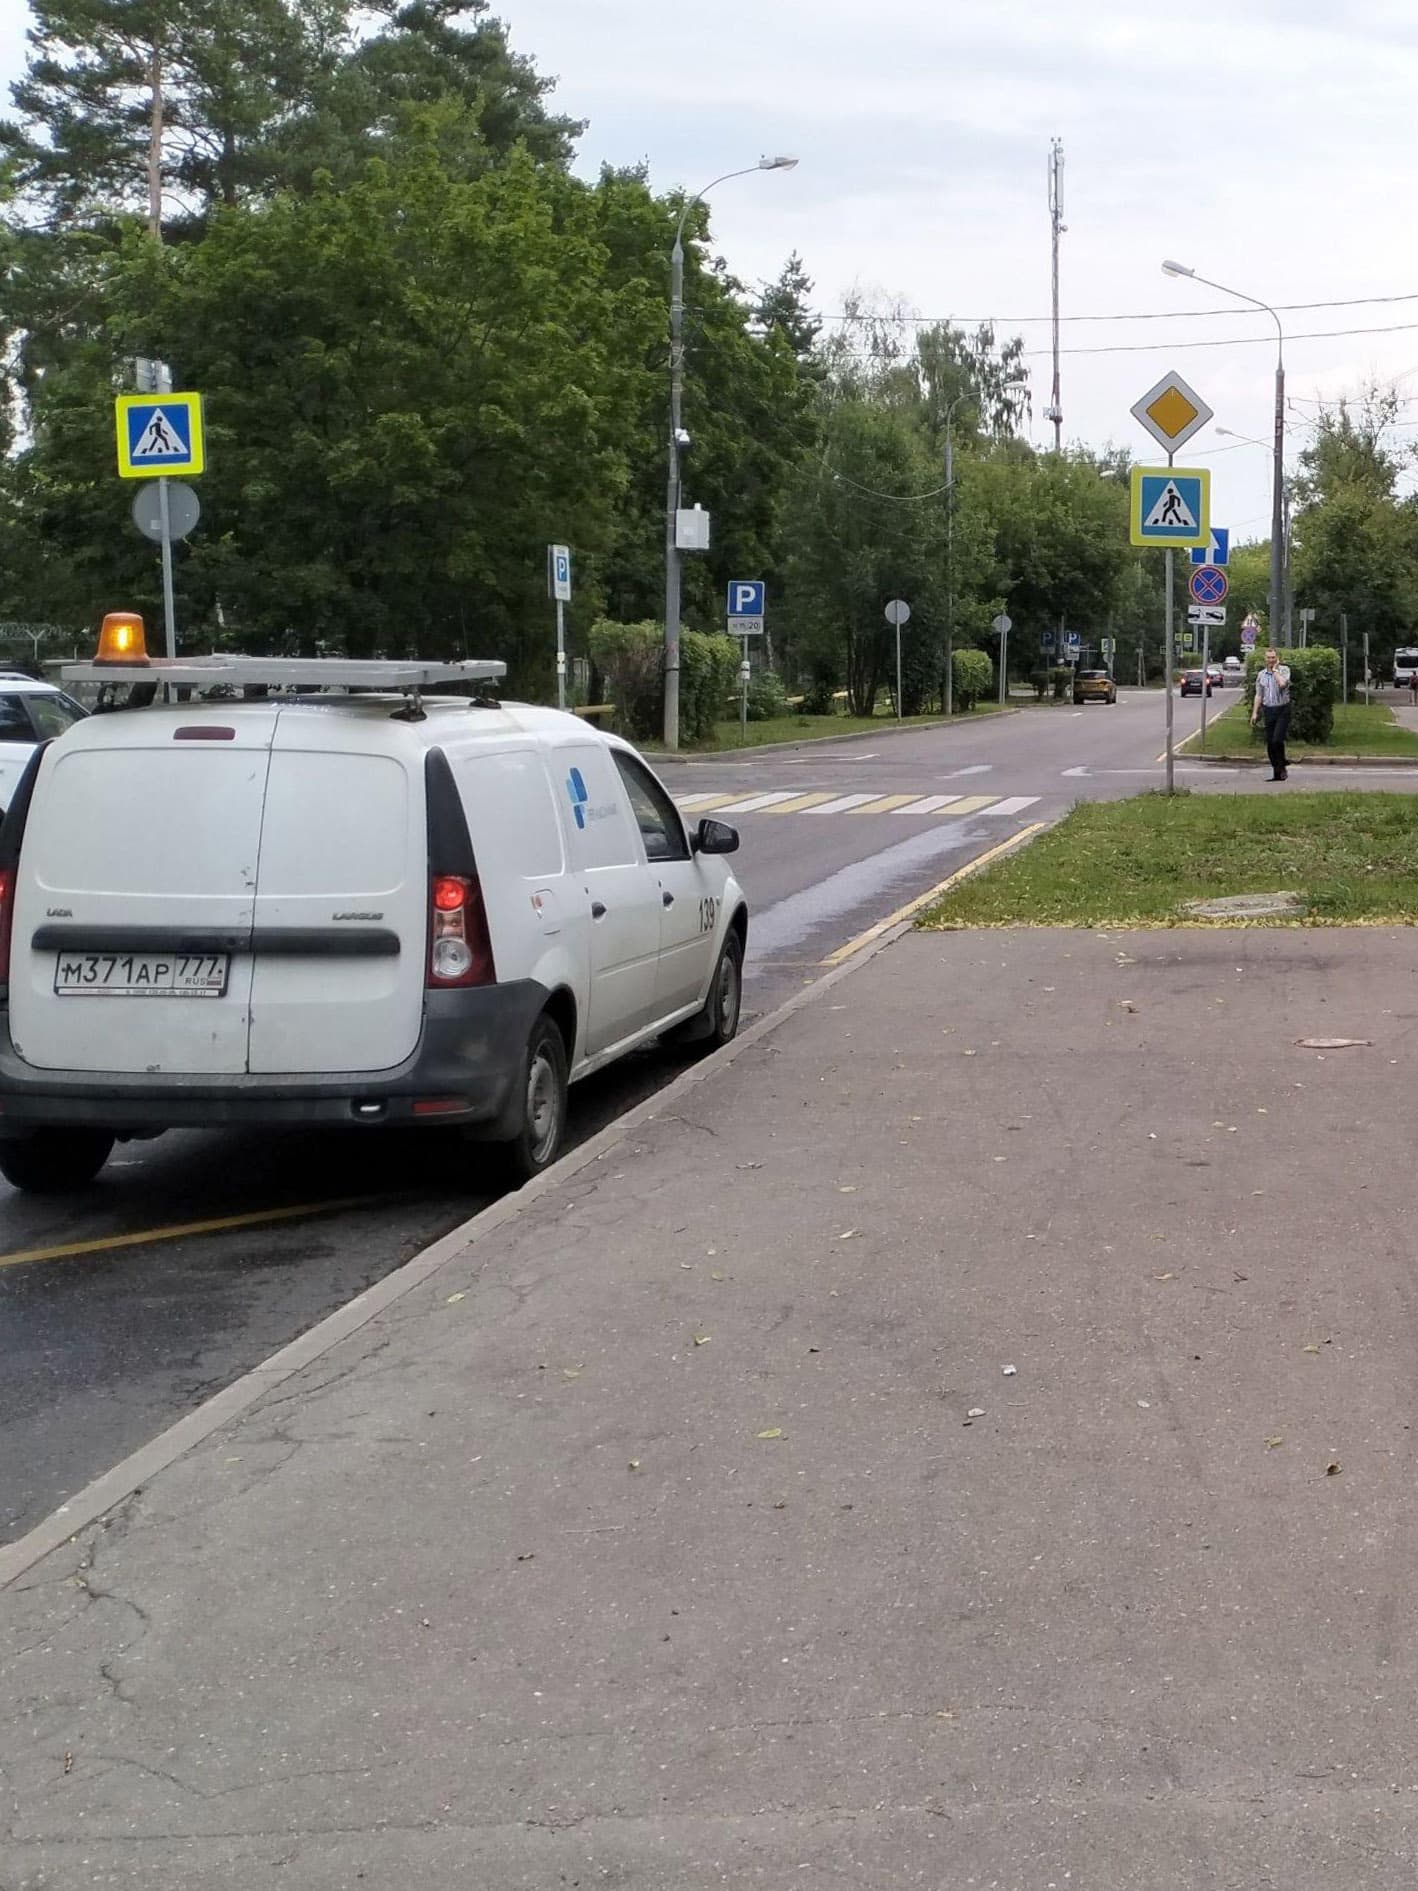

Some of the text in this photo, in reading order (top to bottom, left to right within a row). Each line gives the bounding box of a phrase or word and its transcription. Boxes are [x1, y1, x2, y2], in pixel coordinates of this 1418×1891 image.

[735, 585, 756, 612] P
[63, 956, 219, 984] М371АР 777
[185, 977, 206, 986] RUS
